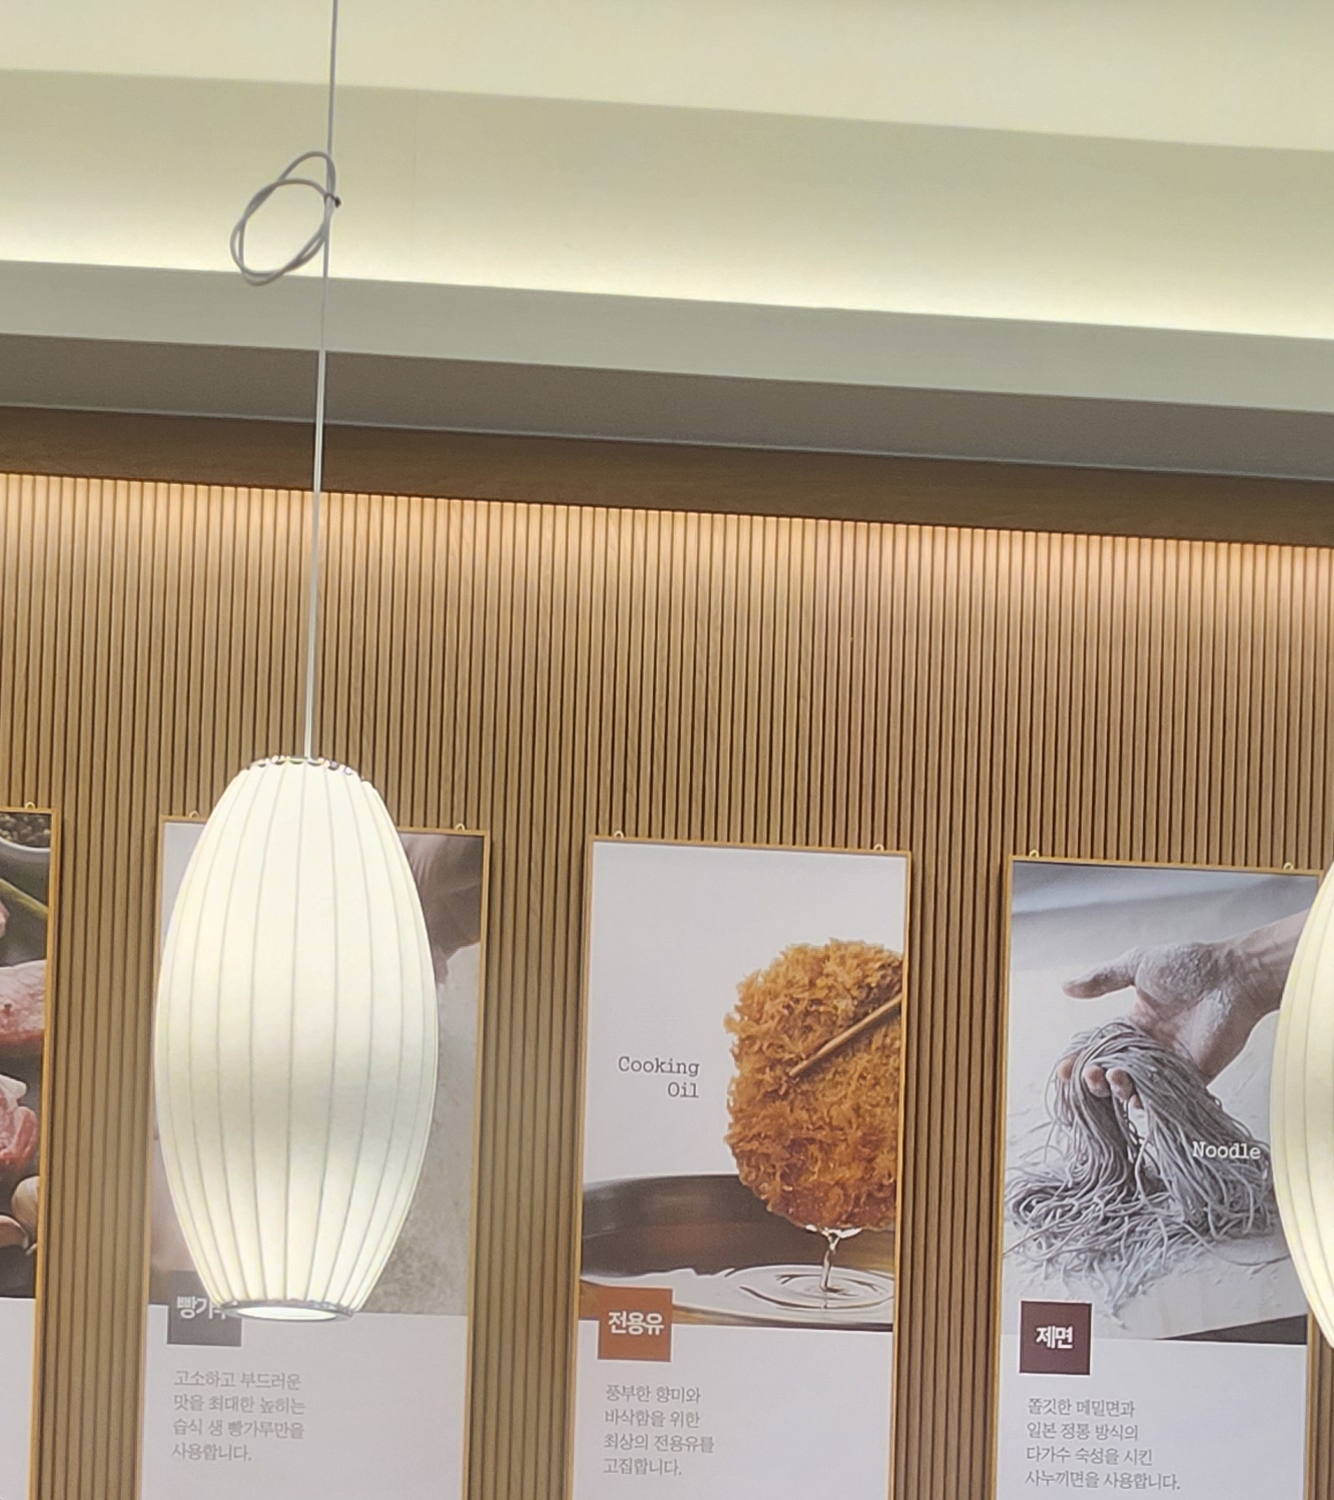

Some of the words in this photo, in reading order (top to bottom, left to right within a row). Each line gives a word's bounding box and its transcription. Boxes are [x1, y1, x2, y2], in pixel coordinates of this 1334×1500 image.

[618, 1056, 700, 1077] Cooking
[668, 1082, 699, 1098] Oil
[1192, 1141, 1261, 1159] Noodle
[608, 1311, 664, 1335] 전용유
[1036, 1325, 1073, 1349] 제면
[174, 1370, 236, 1388] 고소하고
[240, 1371, 302, 1391] 부드러운
[174, 1393, 205, 1412] 맛을
[208, 1395, 255, 1413] 최대한
[606, 1384, 652, 1402] 풍부한
[656, 1386, 701, 1404] 향미와
[1028, 1398, 1072, 1416] 쫄깃한
[1076, 1399, 1135, 1417] 메밀면과
[173, 1418, 203, 1436] 습식
[208, 1420, 223, 1437] 생
[228, 1420, 305, 1440] 빵가루만을
[605, 1408, 666, 1428] 바삭함을
[669, 1410, 701, 1429] 위한
[1027, 1421, 1057, 1439] 일본
[1060, 1423, 1091, 1440] 정통
[1095, 1424, 1138, 1441] 방식의
[171, 1442, 252, 1461] 사용합니다.
[604, 1432, 648, 1451] 최상의
[654, 1434, 715, 1454] 전용유를
[1026, 1445, 1071, 1463] 다가수
[1075, 1447, 1119, 1465] 숙성을
[1123, 1448, 1153, 1466] 시킨
[603, 1457, 682, 1476] 고집합니다.
[1025, 1469, 1099, 1488] 사누끼면을
[1103, 1472, 1181, 1490] 사용합니다.
